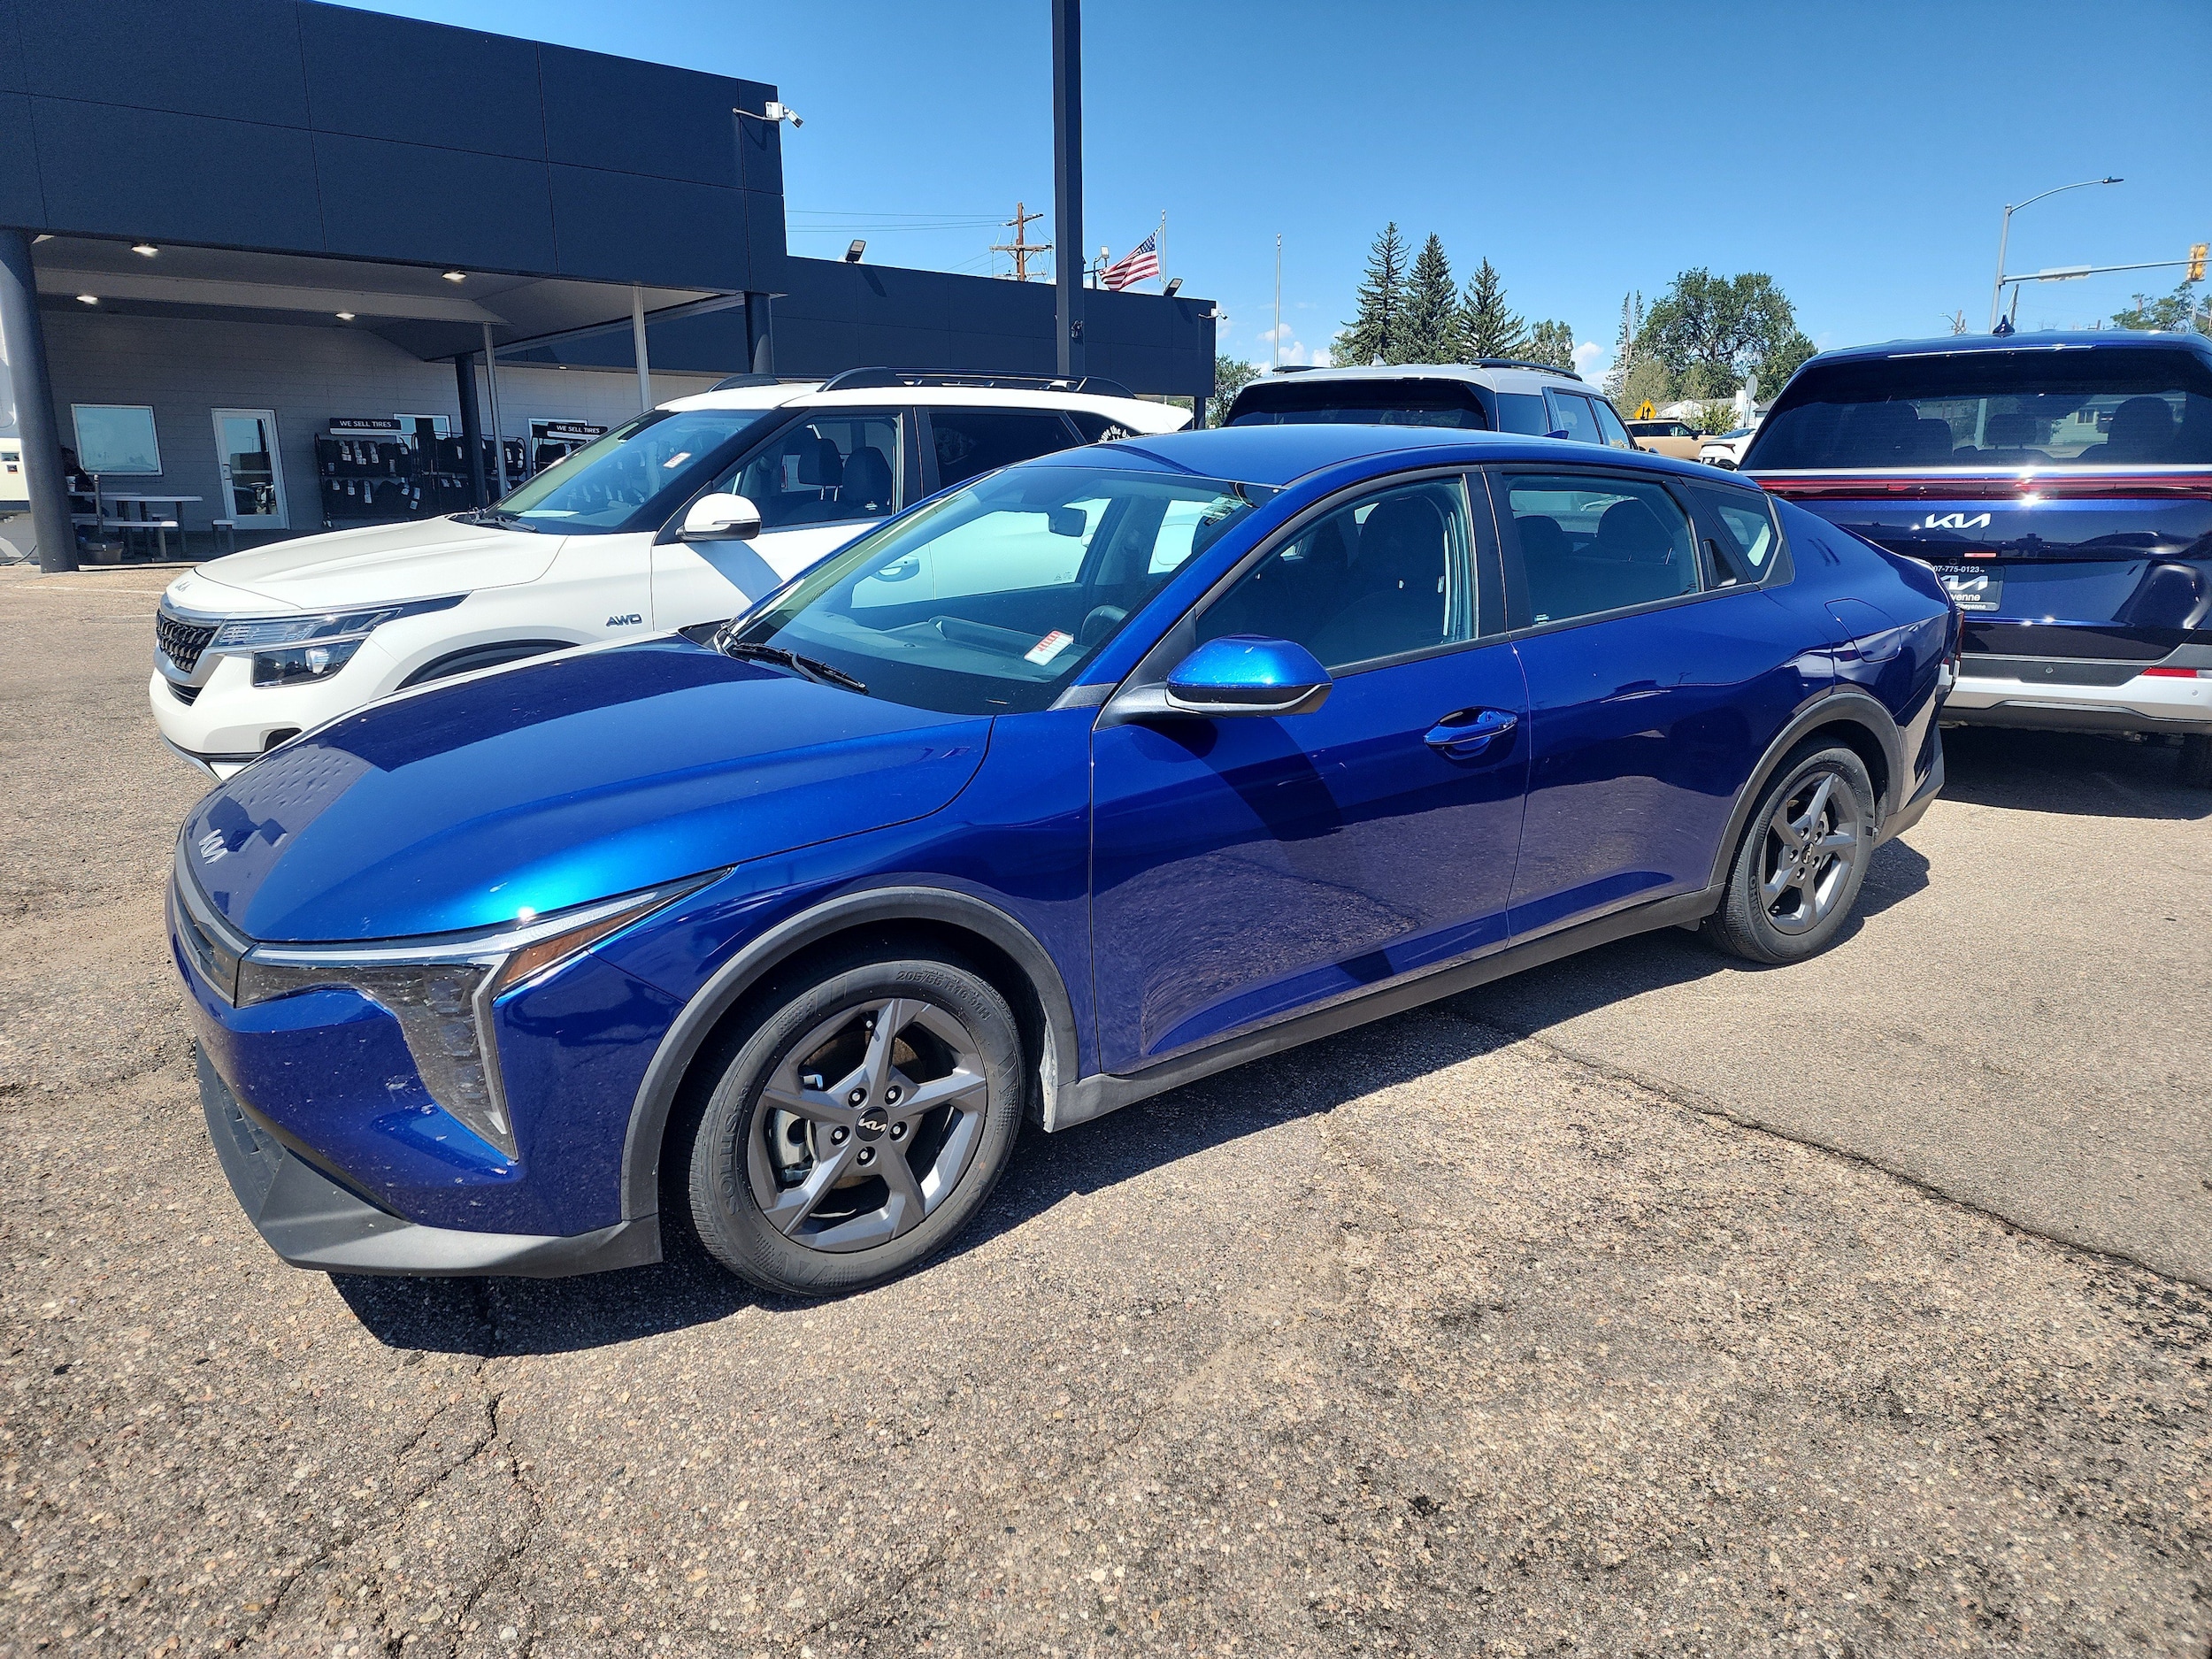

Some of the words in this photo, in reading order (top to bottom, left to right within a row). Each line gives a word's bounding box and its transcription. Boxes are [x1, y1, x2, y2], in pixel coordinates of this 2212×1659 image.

[1925, 513, 1991, 529] KIA
[1940, 575, 1988, 591] IA
[605, 613, 642, 627] AWD
[895, 970, 944, 988] 205/55
[944, 980, 971, 1002] R16
[857, 1118, 887, 1133] KIA
[719, 1112, 740, 1217] SOLUS
